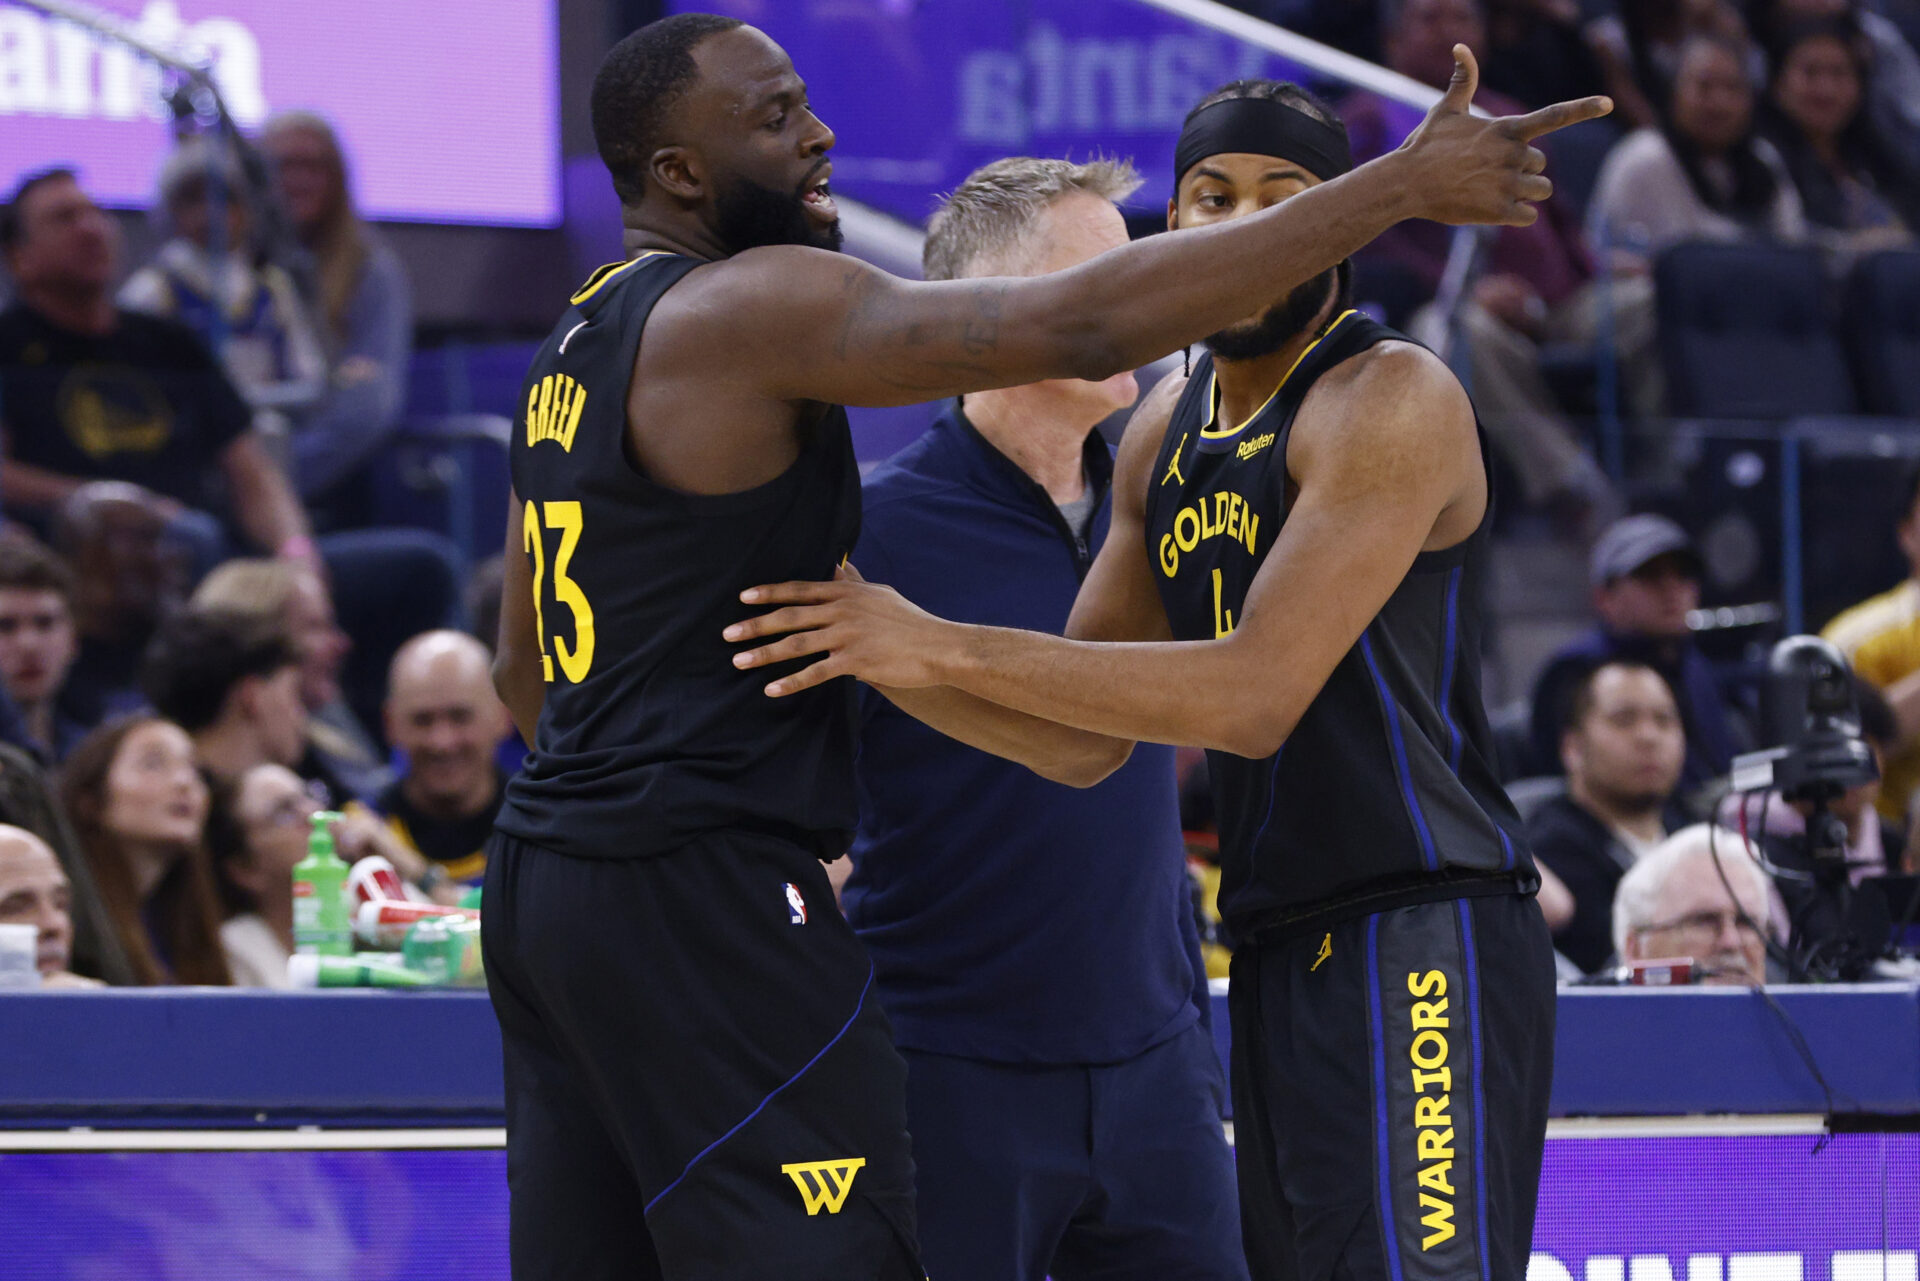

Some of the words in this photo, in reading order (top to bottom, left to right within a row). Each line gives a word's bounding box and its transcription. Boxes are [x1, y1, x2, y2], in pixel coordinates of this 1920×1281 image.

[526, 373, 588, 453] GREEN
[1236, 433, 1275, 460] Rakuten
[1160, 491, 1260, 578] GOLDEN
[1407, 969, 1456, 1252] WARRIORS
